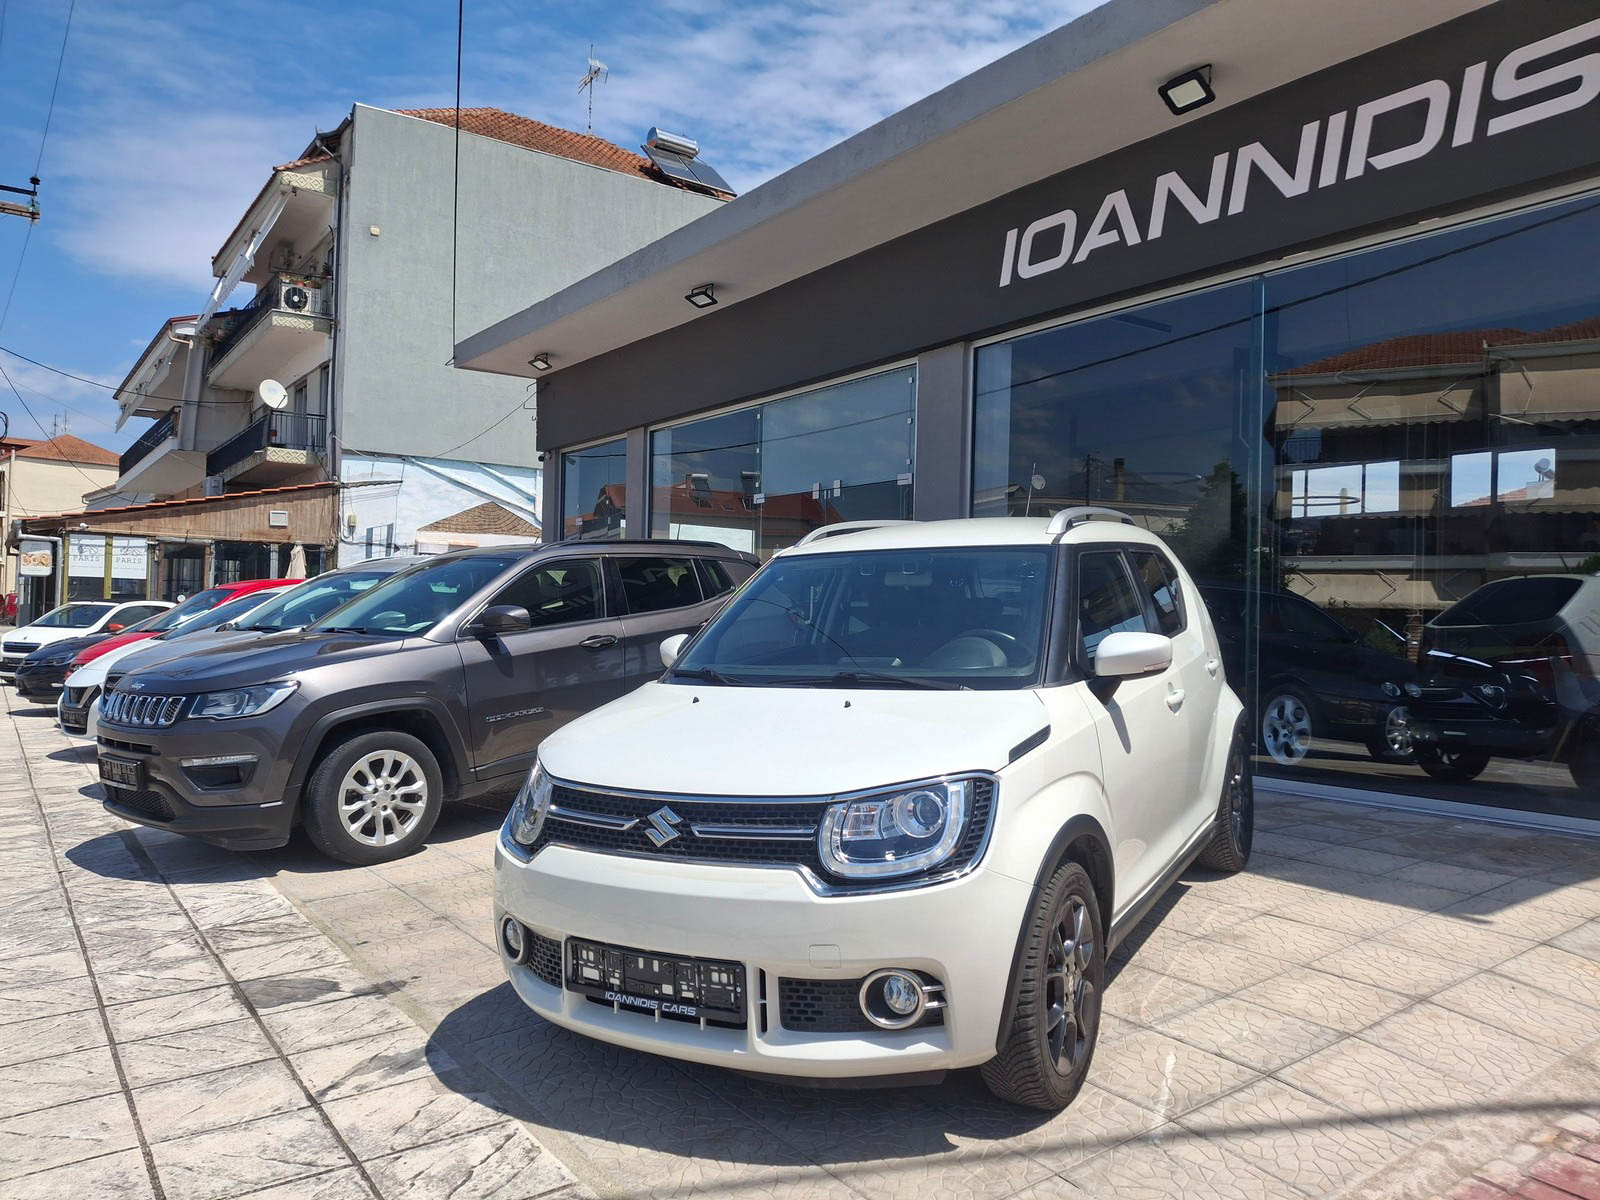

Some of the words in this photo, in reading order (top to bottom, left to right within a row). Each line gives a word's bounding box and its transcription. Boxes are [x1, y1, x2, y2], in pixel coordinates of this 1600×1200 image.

[999, 18, 1600, 288] IOANNIDIS
[604, 991, 659, 1009] IOANNIDIS
[661, 1002, 697, 1016] CARS
